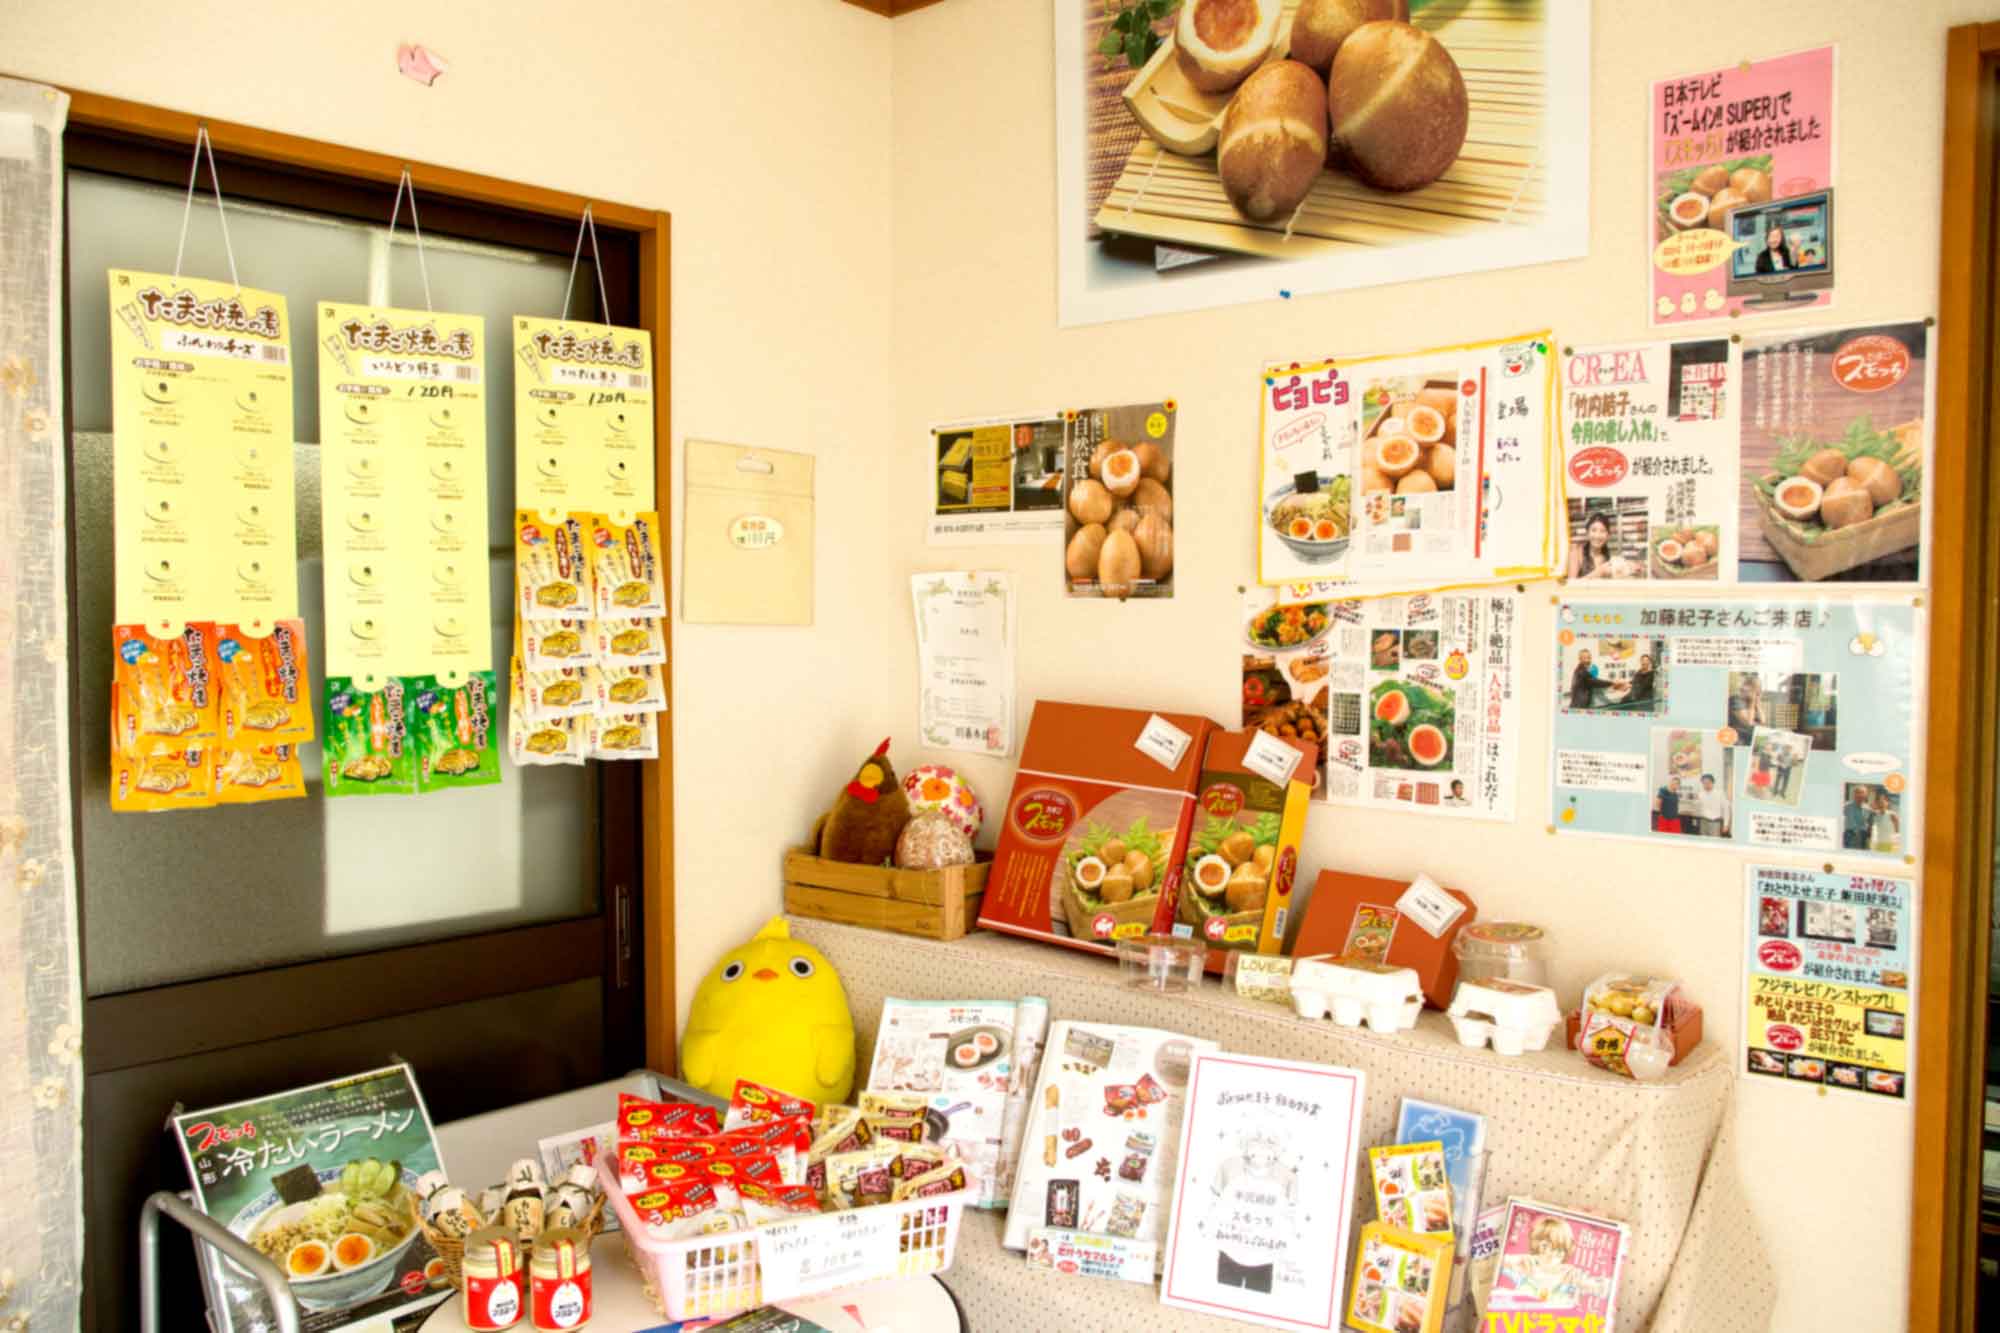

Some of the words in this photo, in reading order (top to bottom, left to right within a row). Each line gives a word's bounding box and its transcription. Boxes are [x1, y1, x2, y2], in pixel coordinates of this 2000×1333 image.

[1664, 73, 1722, 108] 日本テレビ
[1726, 116, 1821, 154] が紹介されました
[139, 289, 281, 338] たまご焼の素
[343, 320, 473, 358] たまご焼の素
[407, 385, 454, 400] 120円
[1071, 416, 1089, 481] 自然食
[217, 1109, 416, 1178] 冷たいラーメン
